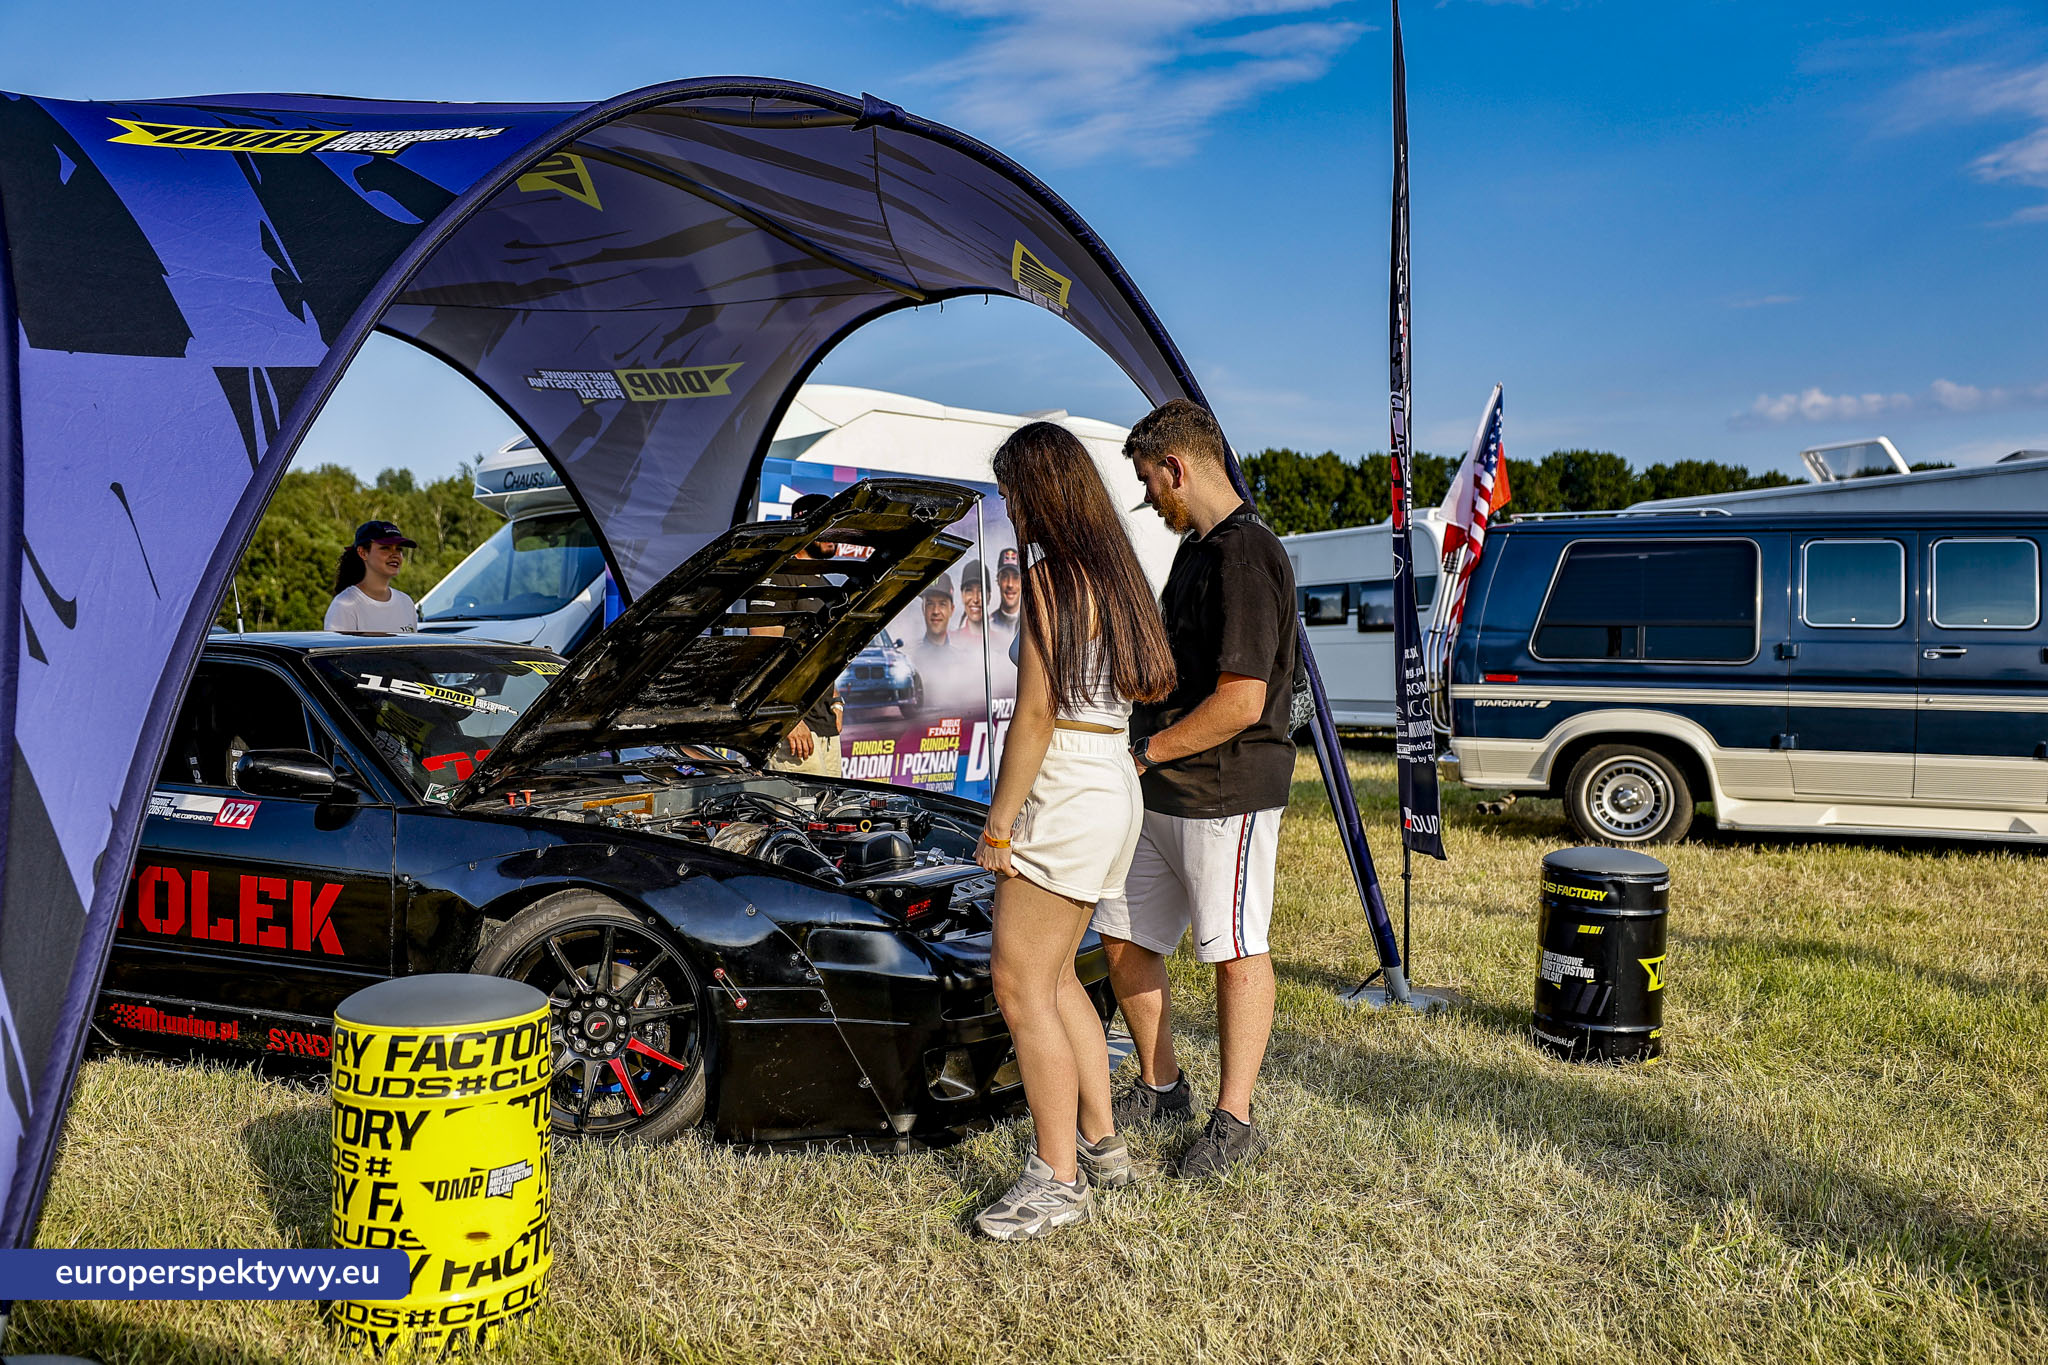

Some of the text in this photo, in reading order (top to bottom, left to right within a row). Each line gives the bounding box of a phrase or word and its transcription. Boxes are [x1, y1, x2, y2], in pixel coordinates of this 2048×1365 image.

[316, 139, 401, 151] POLSKI
[1474, 699, 1537, 709] STARCRAFT
[841, 754, 894, 780] RADOM
[219, 802, 255, 825] 072
[1556, 885, 1608, 902] FACTORY
[118, 863, 345, 956] OLEK
[384, 1012, 551, 1072] FACTOR
[435, 1174, 484, 1202] DMP
[487, 1182, 512, 1197] POLSKI
